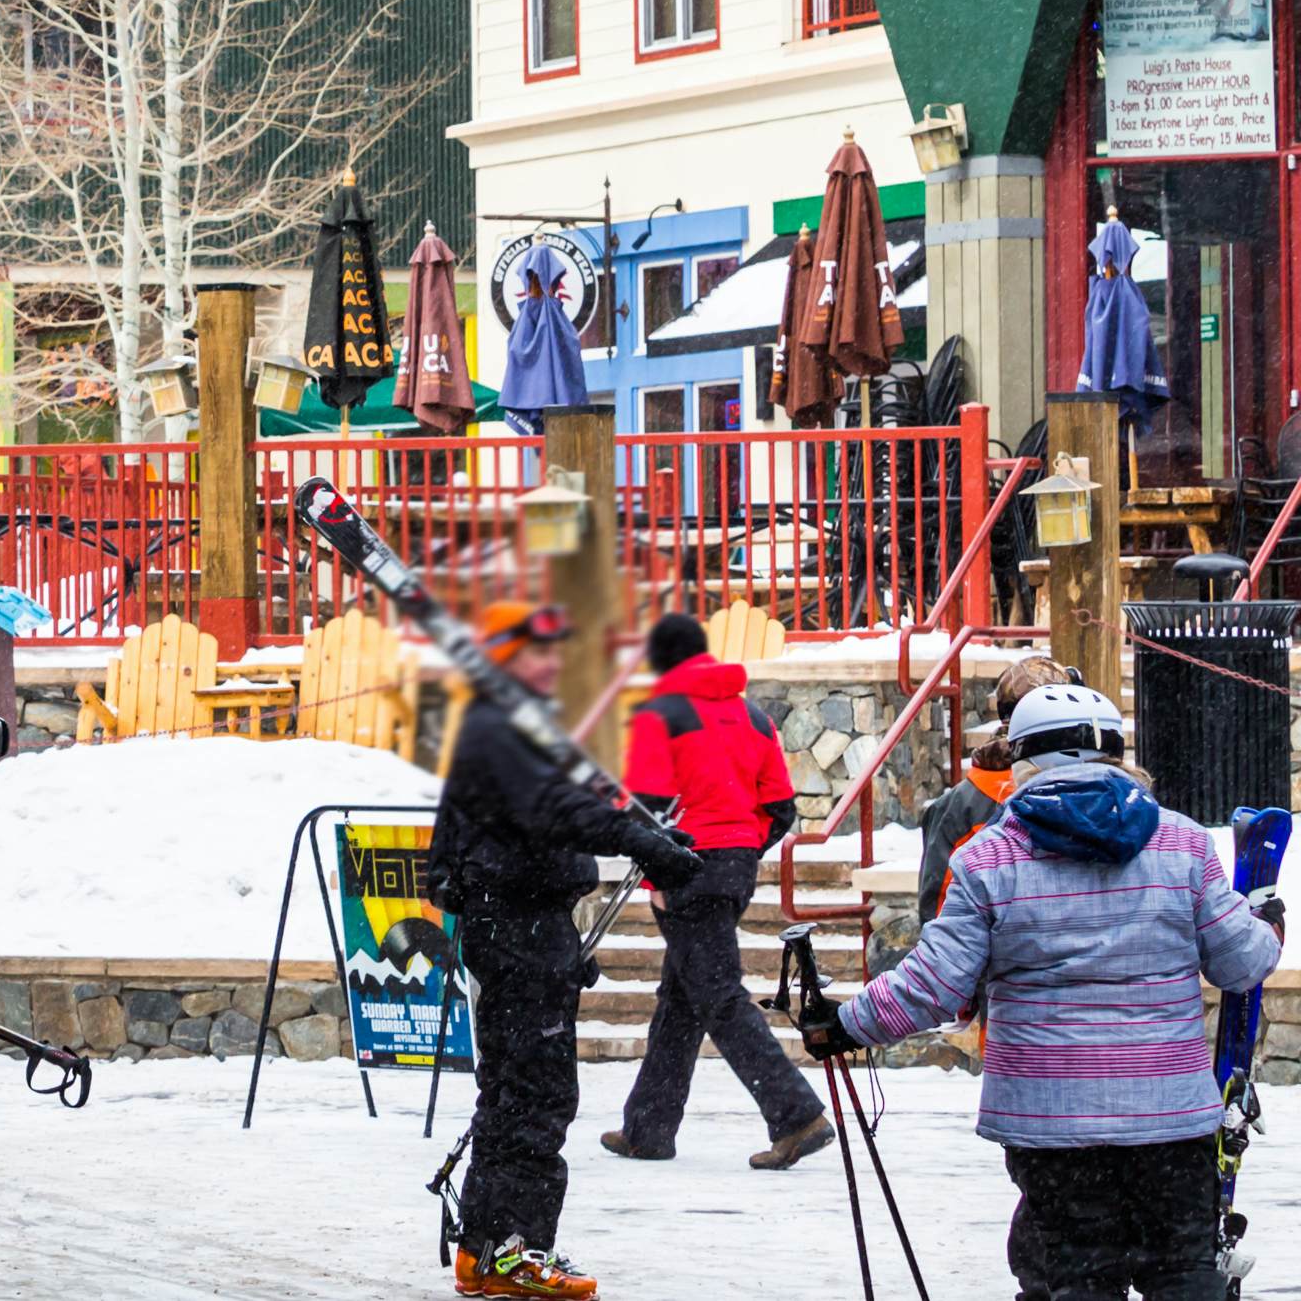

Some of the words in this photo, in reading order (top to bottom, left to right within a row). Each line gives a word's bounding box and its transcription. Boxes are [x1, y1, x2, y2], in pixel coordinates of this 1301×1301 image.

[1143, 60, 1171, 76] Luigi's
[1175, 59, 1201, 72] Pasta
[1204, 58, 1232, 71] House
[1126, 79, 1183, 95] PROgressive
[1187, 76, 1218, 89] HAPPY
[1222, 74, 1251, 88] HOUR
[1110, 101, 1140, 114] 3-6pm
[1144, 97, 1172, 111] $1.00
[1176, 97, 1201, 109] Coors
[1205, 95, 1228, 111] Light
[1232, 92, 1259, 107] Draft
[1263, 92, 1269, 105] &
[1115, 118, 1137, 131] 16oz
[1141, 116, 1182, 133] Keystone
[1186, 115, 1209, 131] Light
[1242, 112, 1265, 124] Price
[1110, 137, 1153, 150] increases
[1157, 134, 1186, 148] $0.25
[1189, 132, 1215, 149] Every
[1220, 132, 1231, 144] 15
[1235, 131, 1271, 145] Minutes
[360, 1002, 405, 1019] SUNDAY
[371, 1019, 412, 1034] WARREN
